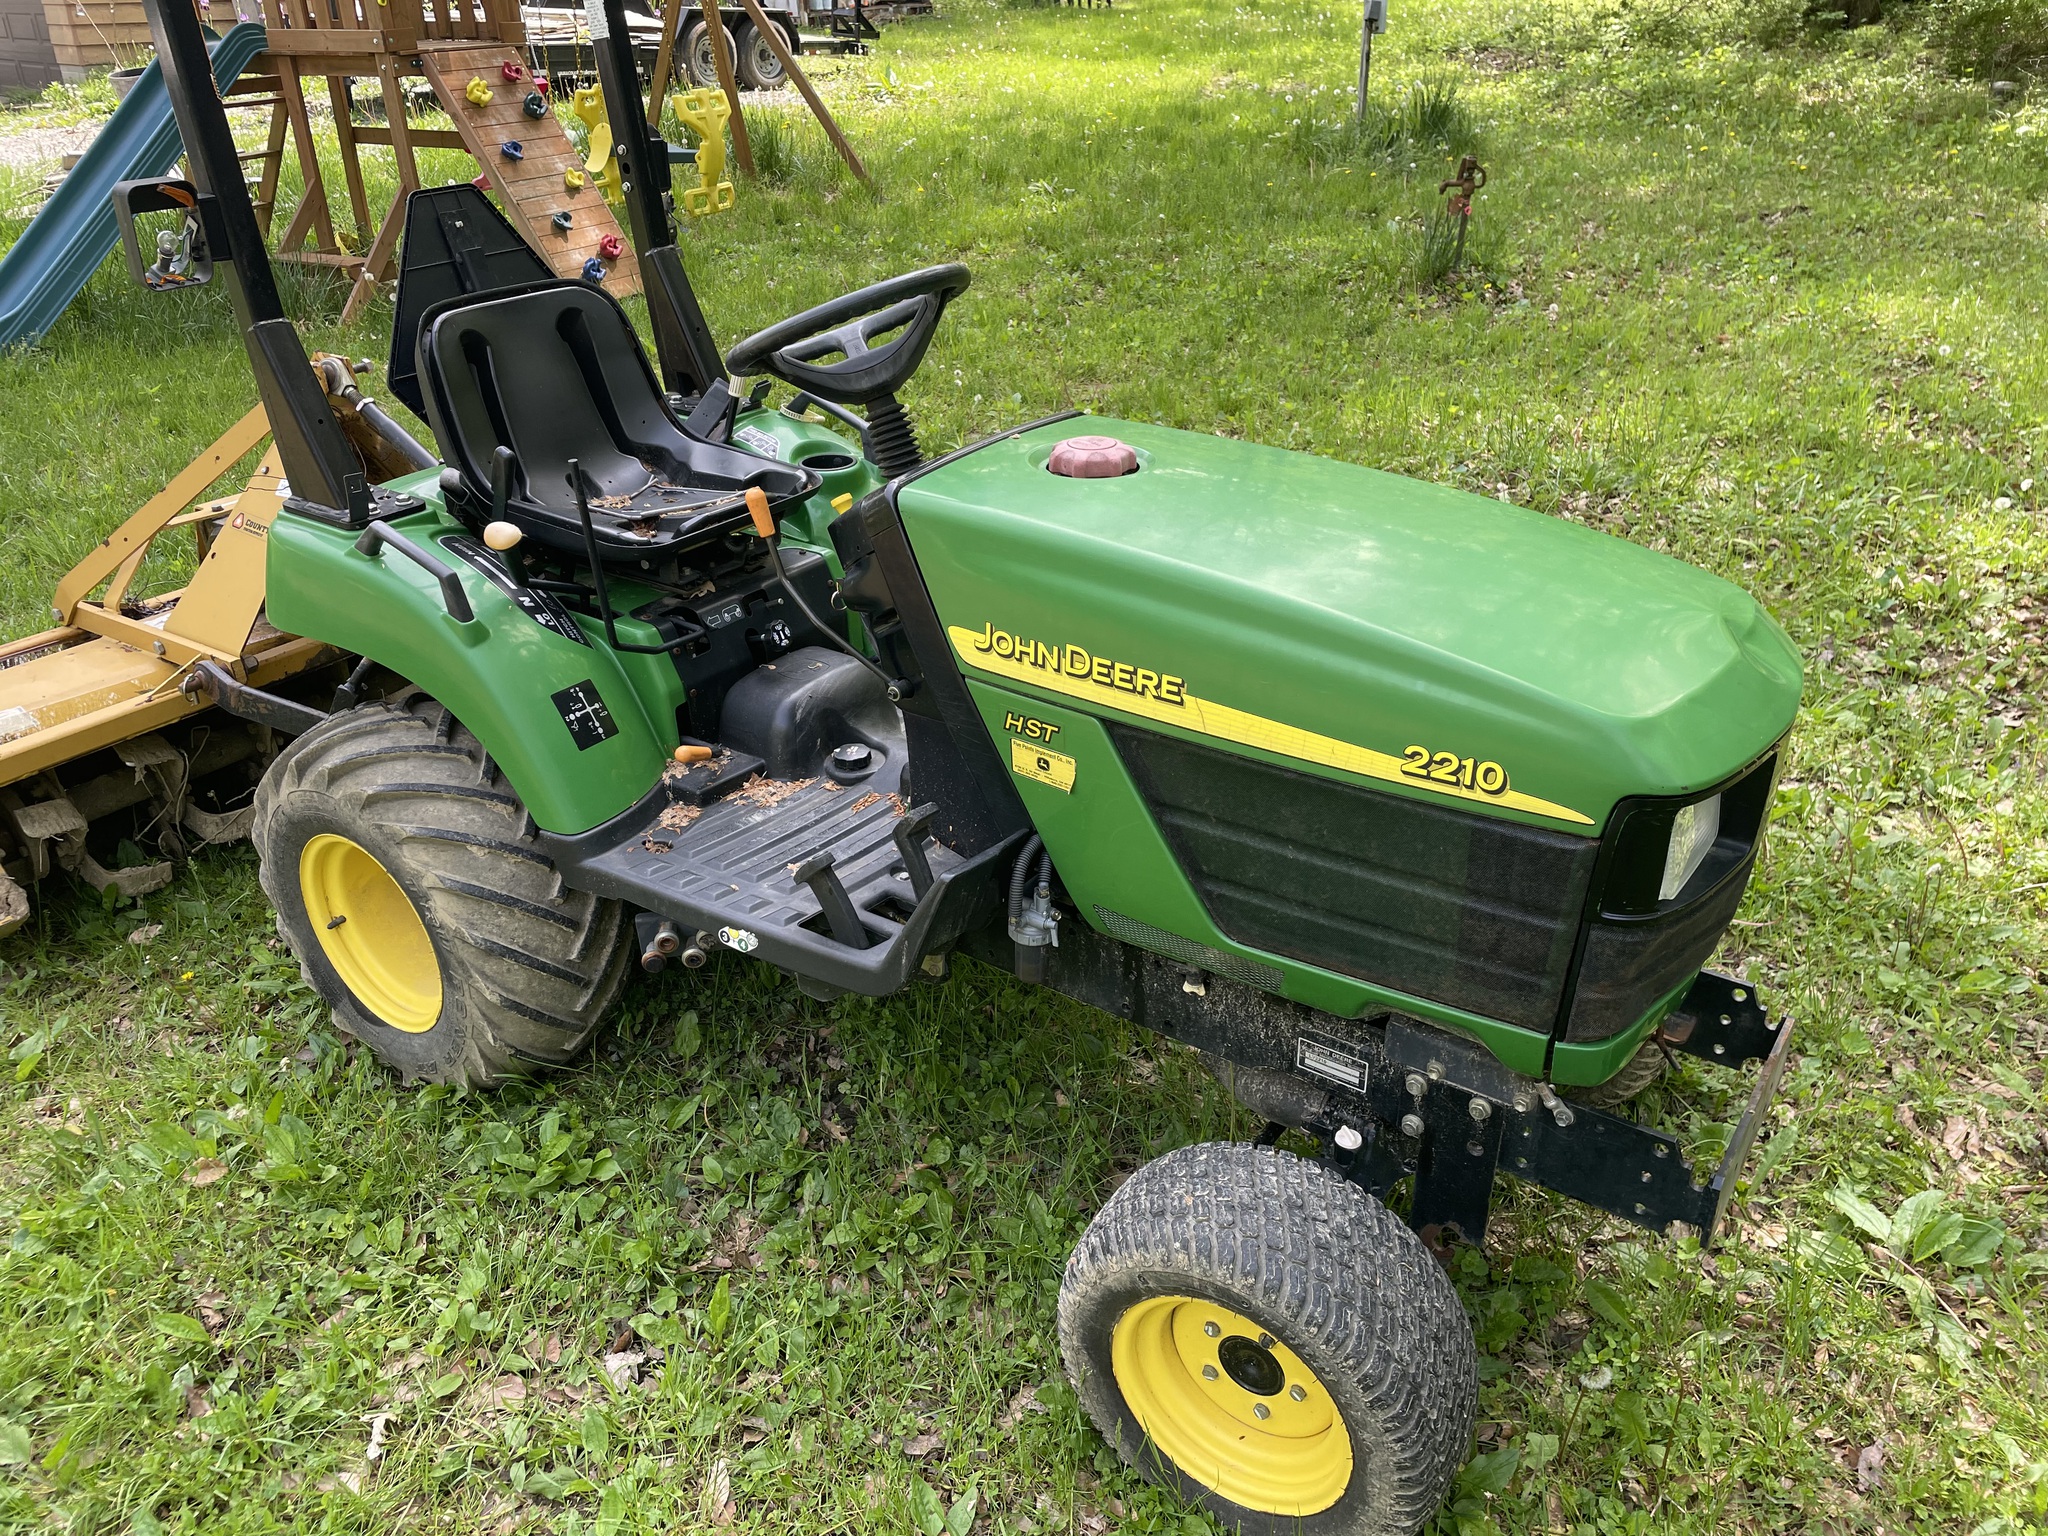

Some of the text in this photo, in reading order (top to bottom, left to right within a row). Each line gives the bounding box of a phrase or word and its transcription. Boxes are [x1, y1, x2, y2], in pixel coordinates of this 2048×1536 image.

[974, 621, 1186, 707] JOHN DEERE
[1003, 710, 1061, 743] HST
[1400, 743, 1509, 797] 2210
